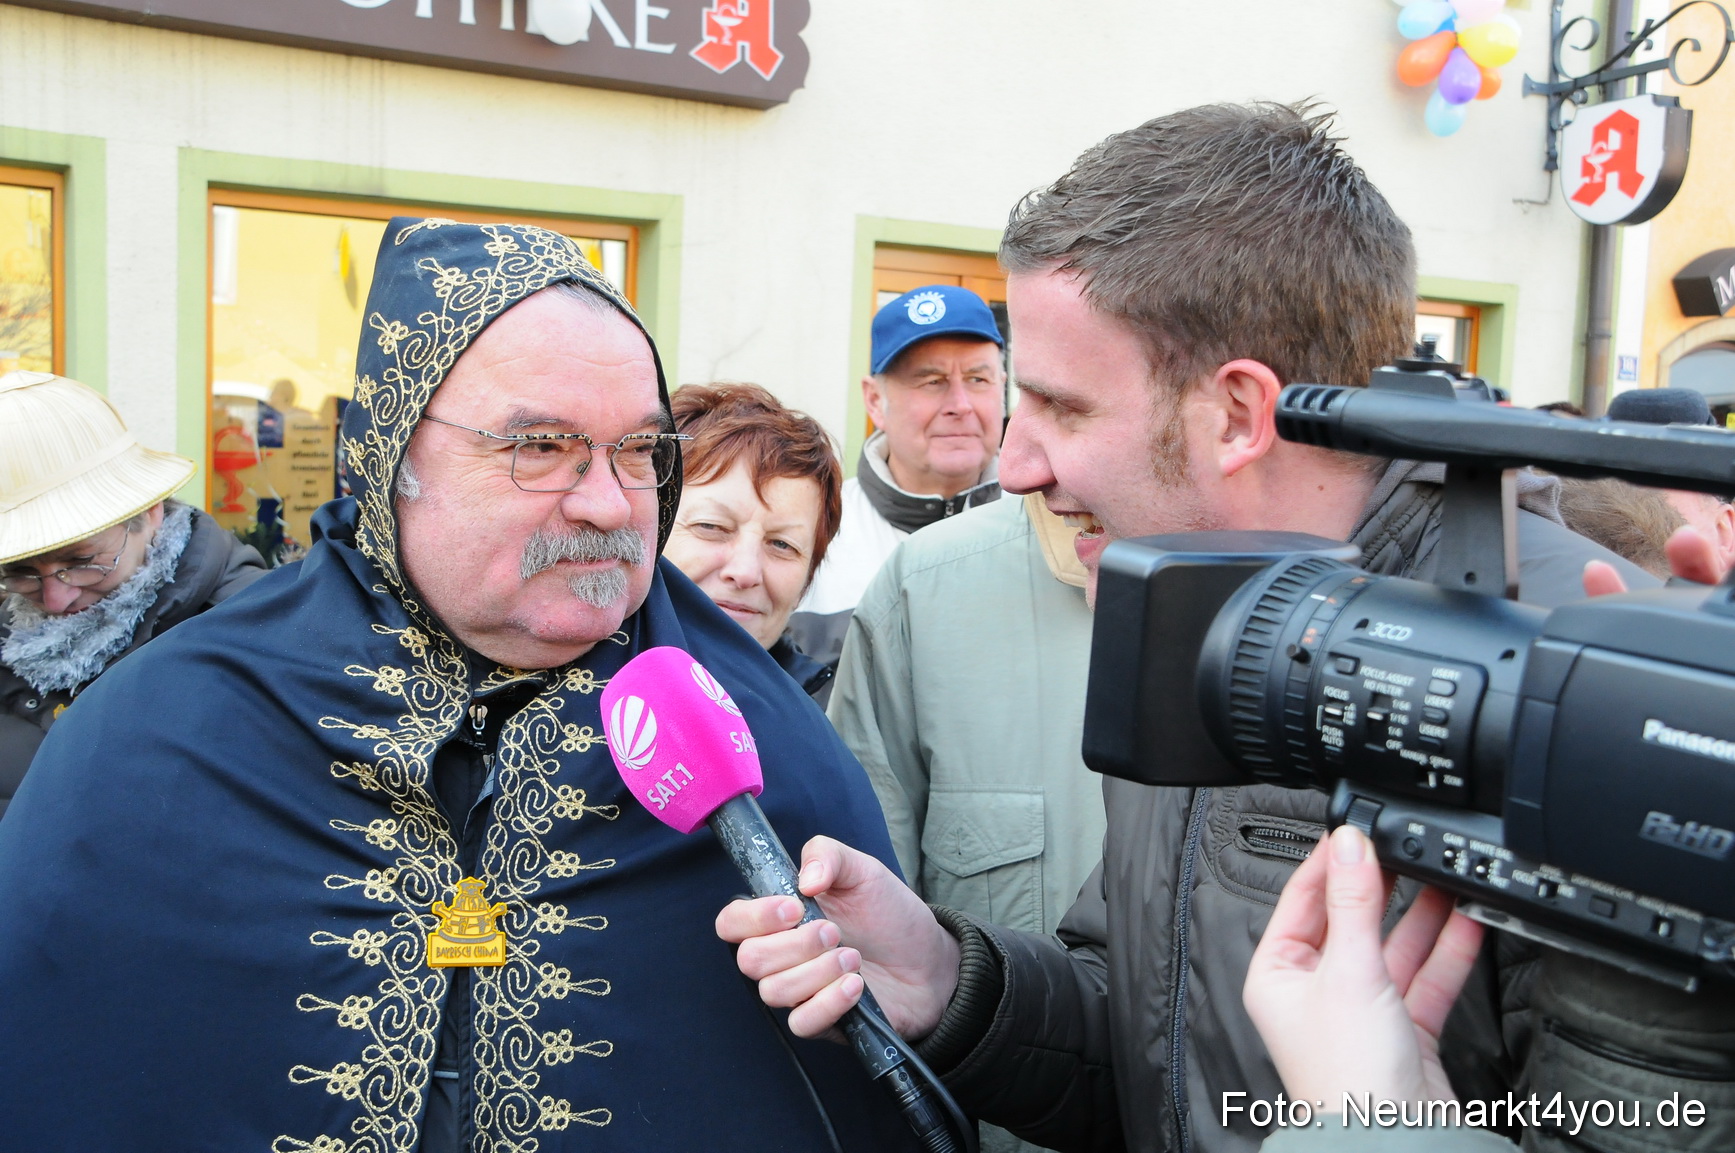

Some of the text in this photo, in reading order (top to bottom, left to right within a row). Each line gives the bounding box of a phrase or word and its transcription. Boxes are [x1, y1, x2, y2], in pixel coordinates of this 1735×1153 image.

[1369, 622, 1413, 641] 3CCD
[1360, 665, 1415, 687] FOCUS ASSIST
[1431, 667, 1461, 681] USER1
[1324, 685, 1349, 700] FOCUS
[1377, 682, 1404, 697] FILTER
[1424, 694, 1455, 709] USER2
[1321, 734, 1345, 748] AUTO
[646, 762, 695, 811] SAT.1
